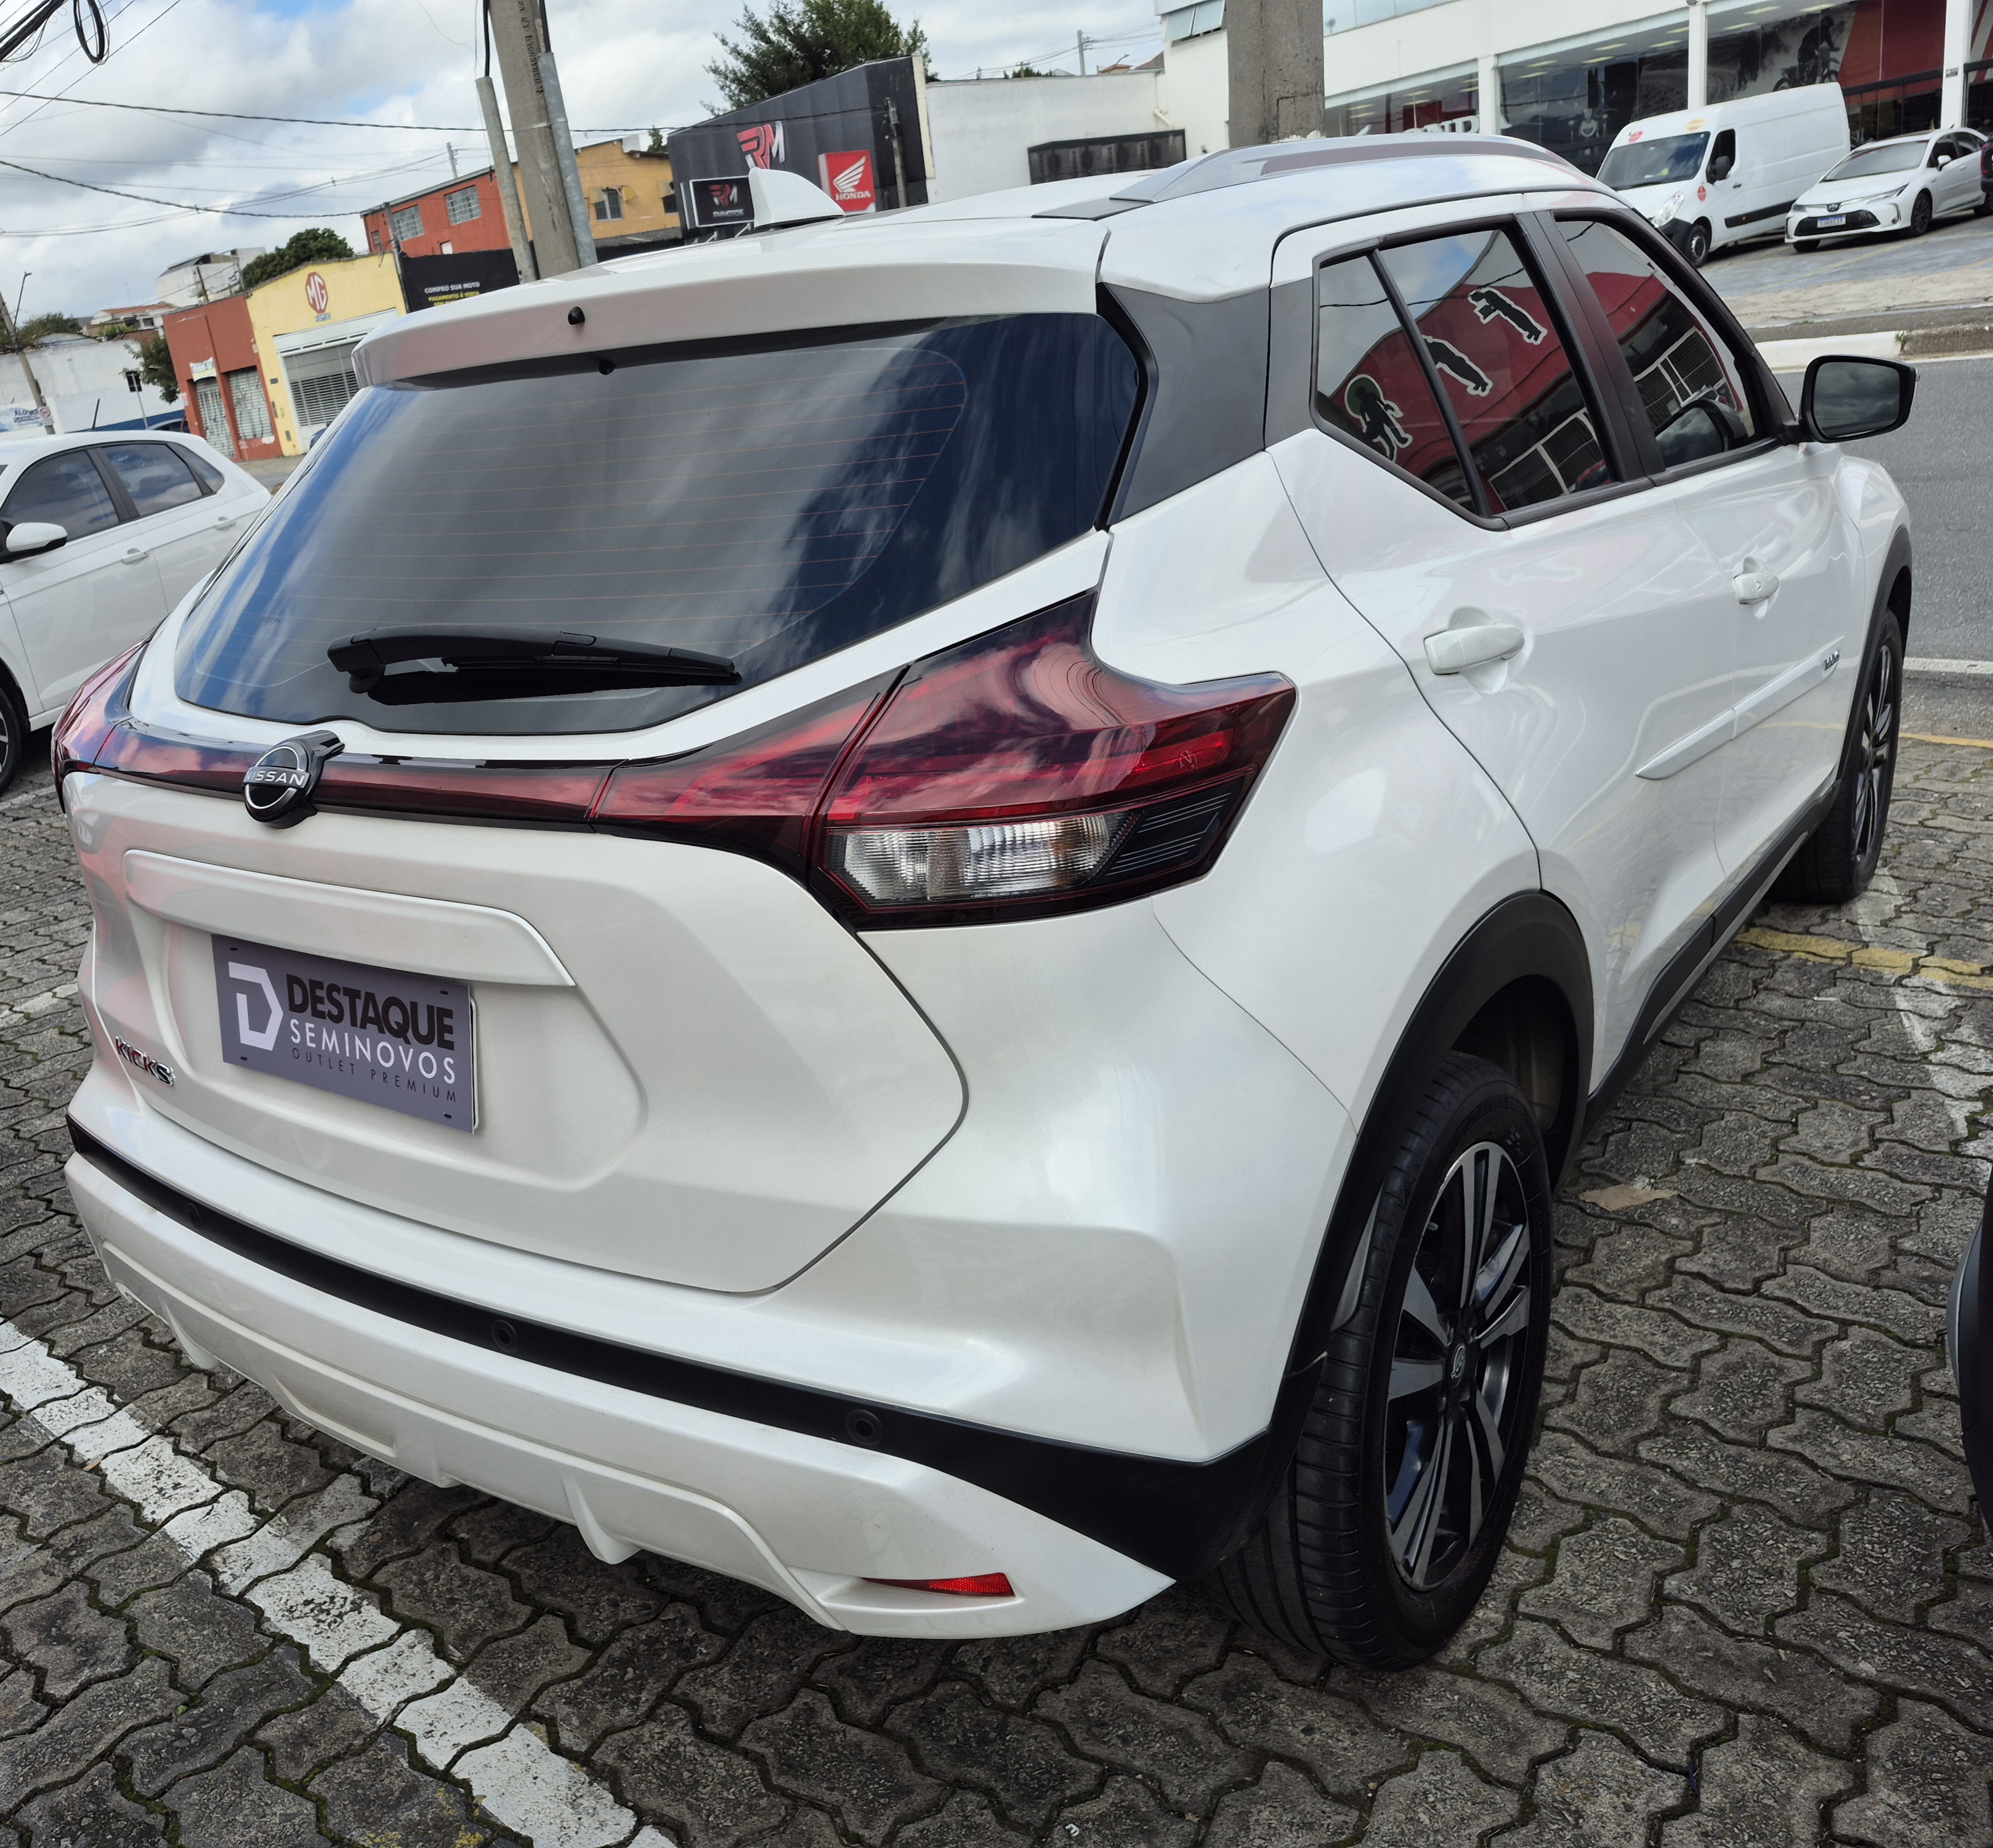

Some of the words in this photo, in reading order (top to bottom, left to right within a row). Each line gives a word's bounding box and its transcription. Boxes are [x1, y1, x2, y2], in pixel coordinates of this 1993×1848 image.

[835, 191, 871, 201] HONDA
[306, 275, 328, 310] MG
[424, 285, 449, 294] COMPRO
[246, 771, 305, 786] NISSAN
[286, 973, 455, 1051] DESTAQUE
[115, 1035, 175, 1086] KICKS
[289, 1018, 456, 1084] SEMINOVOS
[292, 1048, 355, 1075] OUTLET
[371, 1068, 456, 1103] PREMIUM
